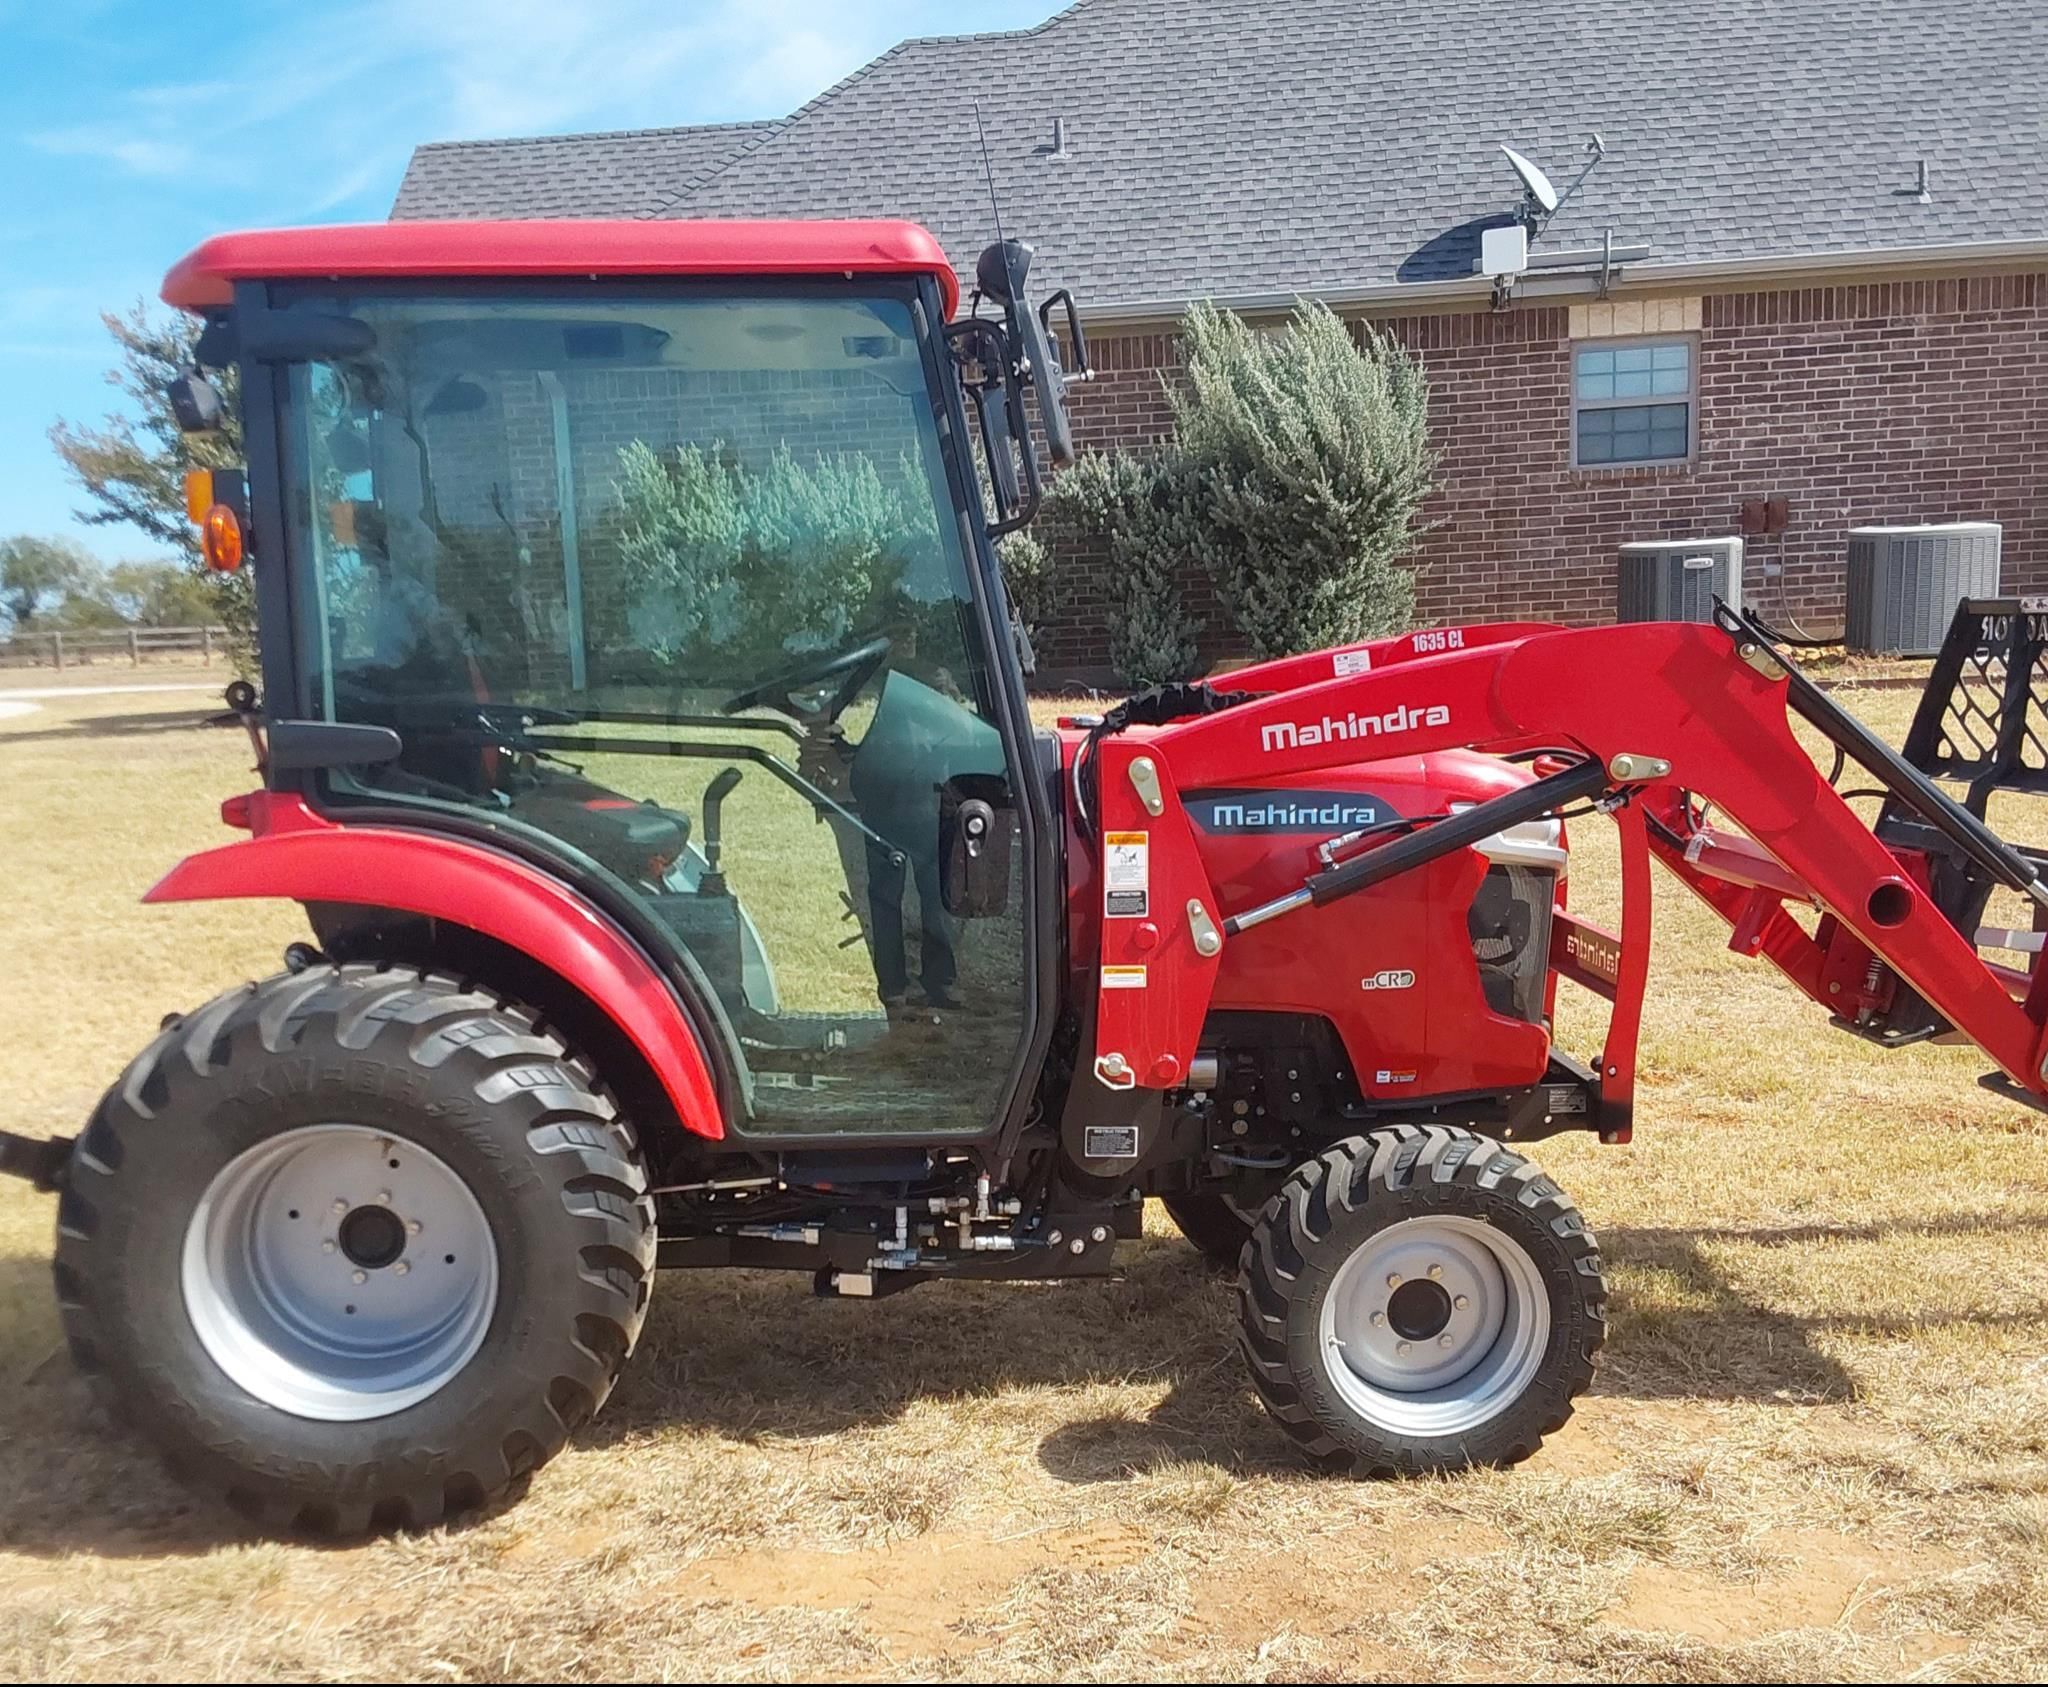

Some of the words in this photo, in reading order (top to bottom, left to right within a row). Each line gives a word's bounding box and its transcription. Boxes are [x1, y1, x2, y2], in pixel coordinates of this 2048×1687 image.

[1412, 631, 1445, 653] 1635
[1448, 630, 1464, 649] CL
[1260, 704, 1450, 752] Mahindra
[1213, 804, 1375, 827] Mahindra
